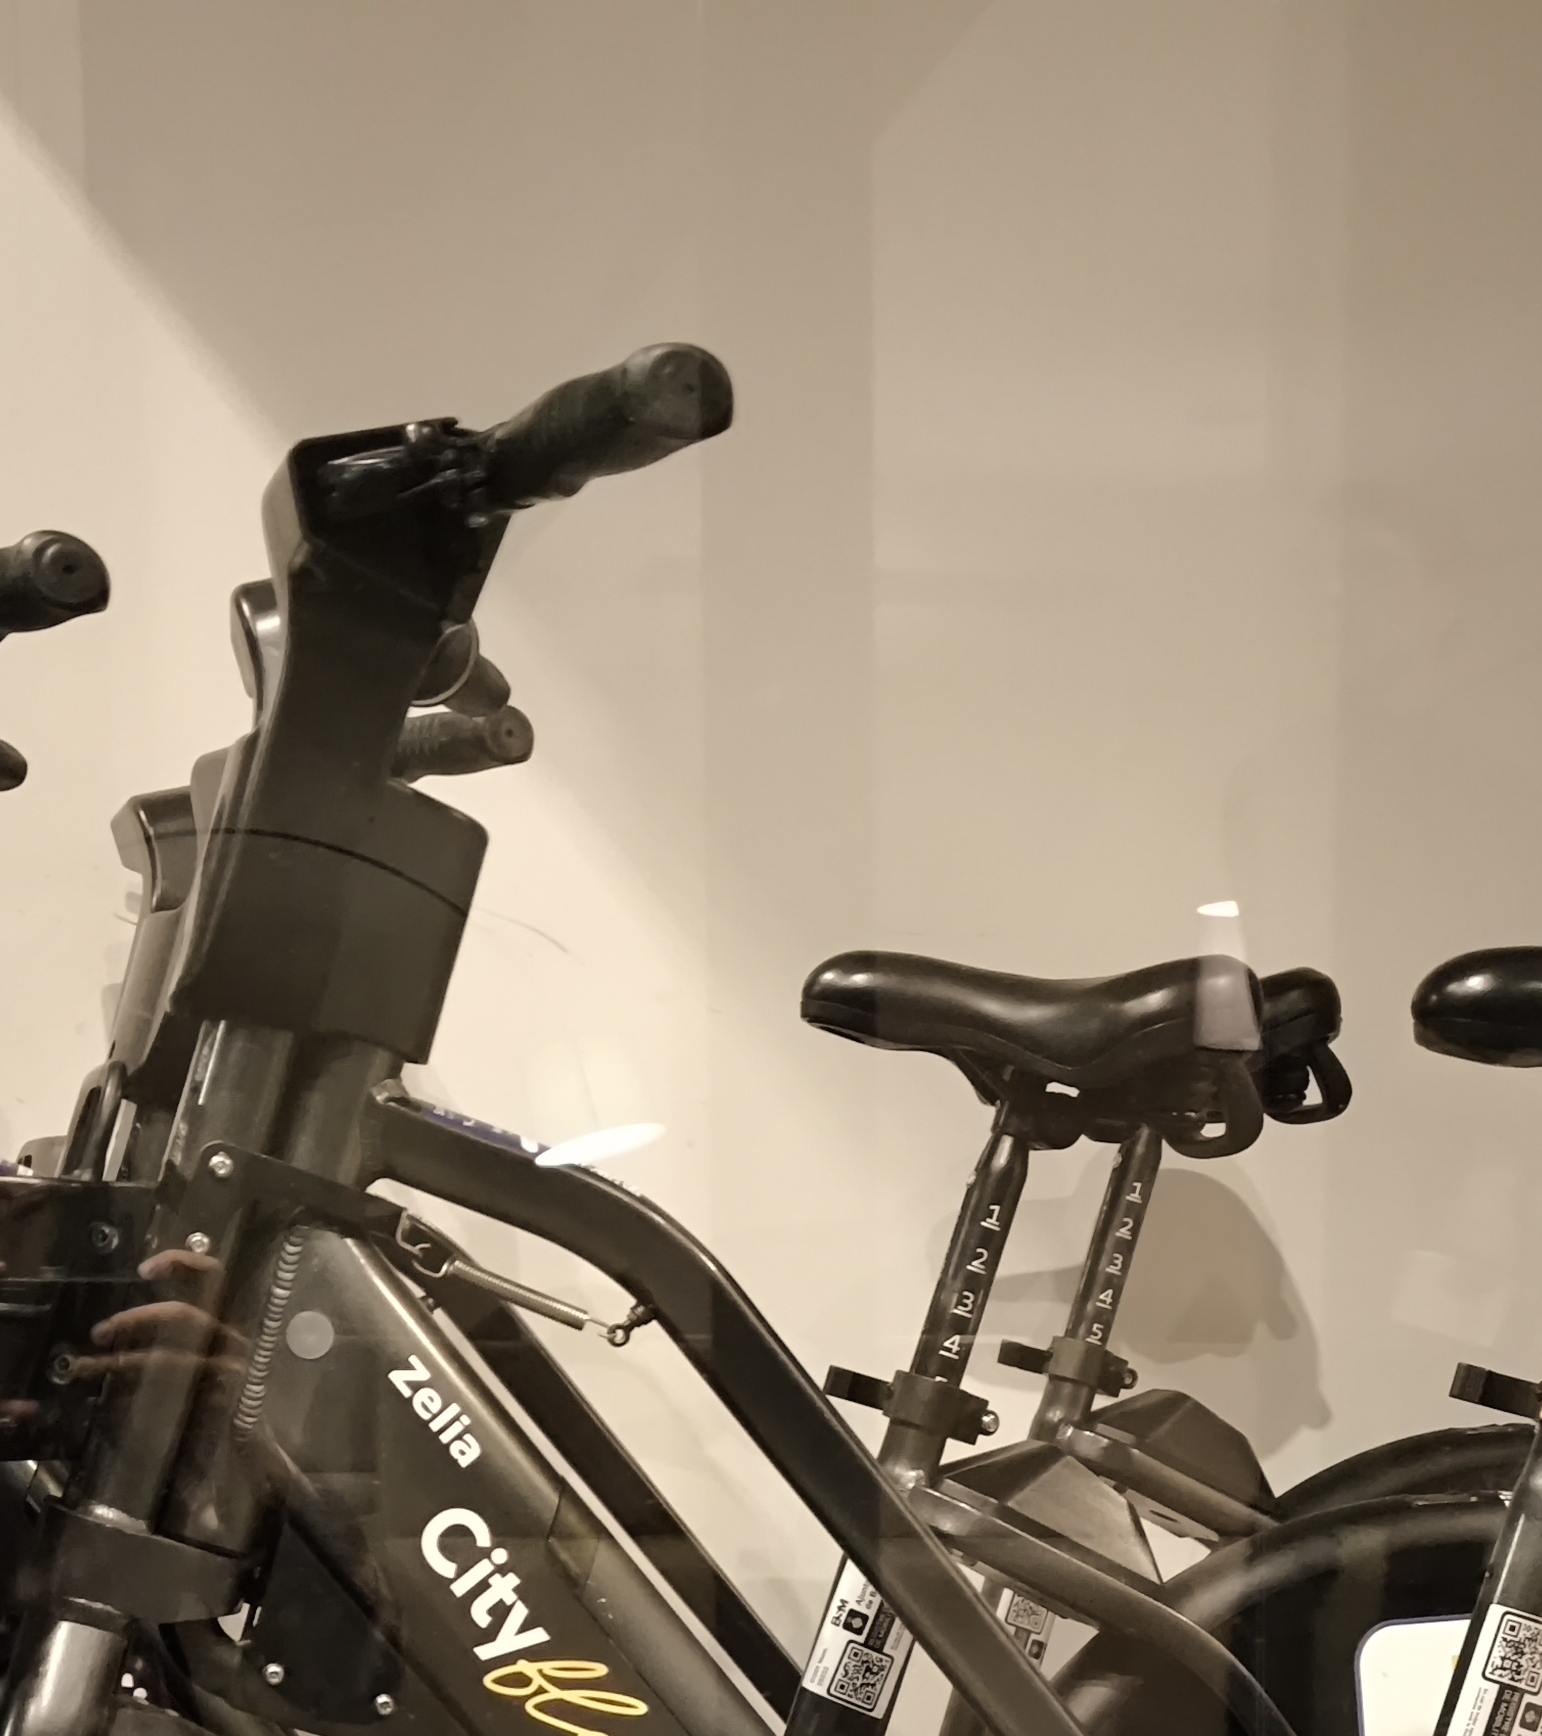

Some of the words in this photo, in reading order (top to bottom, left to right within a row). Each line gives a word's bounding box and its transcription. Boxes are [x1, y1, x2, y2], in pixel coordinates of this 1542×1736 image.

[1129, 1181, 1142, 1200] 1
[984, 1205, 1001, 1226] 1
[1118, 1217, 1134, 1236] 2
[970, 1247, 989, 1270] 2
[1109, 1253, 1124, 1271] 3
[955, 1291, 975, 1313] 3
[1099, 1288, 1114, 1306] 4
[1089, 1322, 1105, 1341] 5
[942, 1334, 961, 1355] 4
[388, 1353, 483, 1469] Zelia
